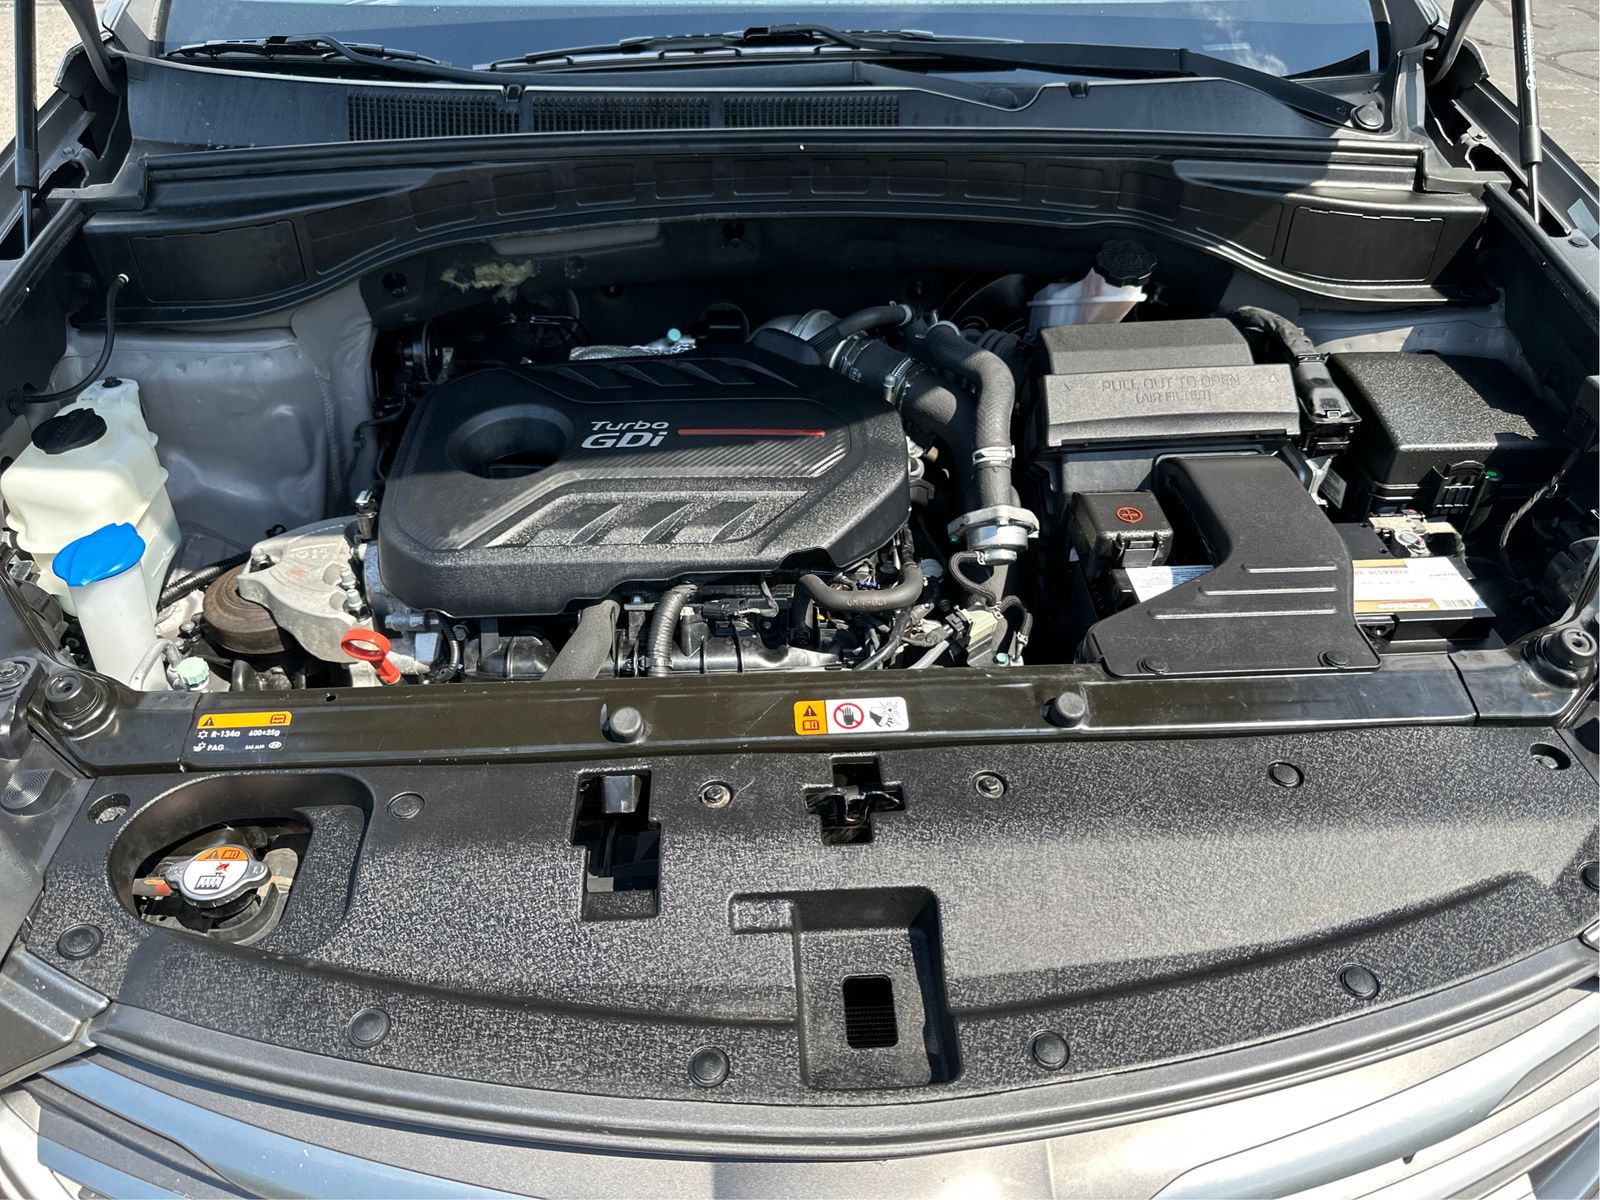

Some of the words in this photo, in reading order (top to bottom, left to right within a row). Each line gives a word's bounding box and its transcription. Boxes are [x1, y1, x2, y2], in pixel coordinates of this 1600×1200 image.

[1101, 378, 1139, 392] PULL
[1143, 376, 1173, 390] OUT
[1178, 375, 1197, 389] TO
[1201, 373, 1241, 388] OPEN
[591, 420, 670, 431] Turbo
[581, 431, 669, 449] GDi
[206, 744, 225, 752] PAG
